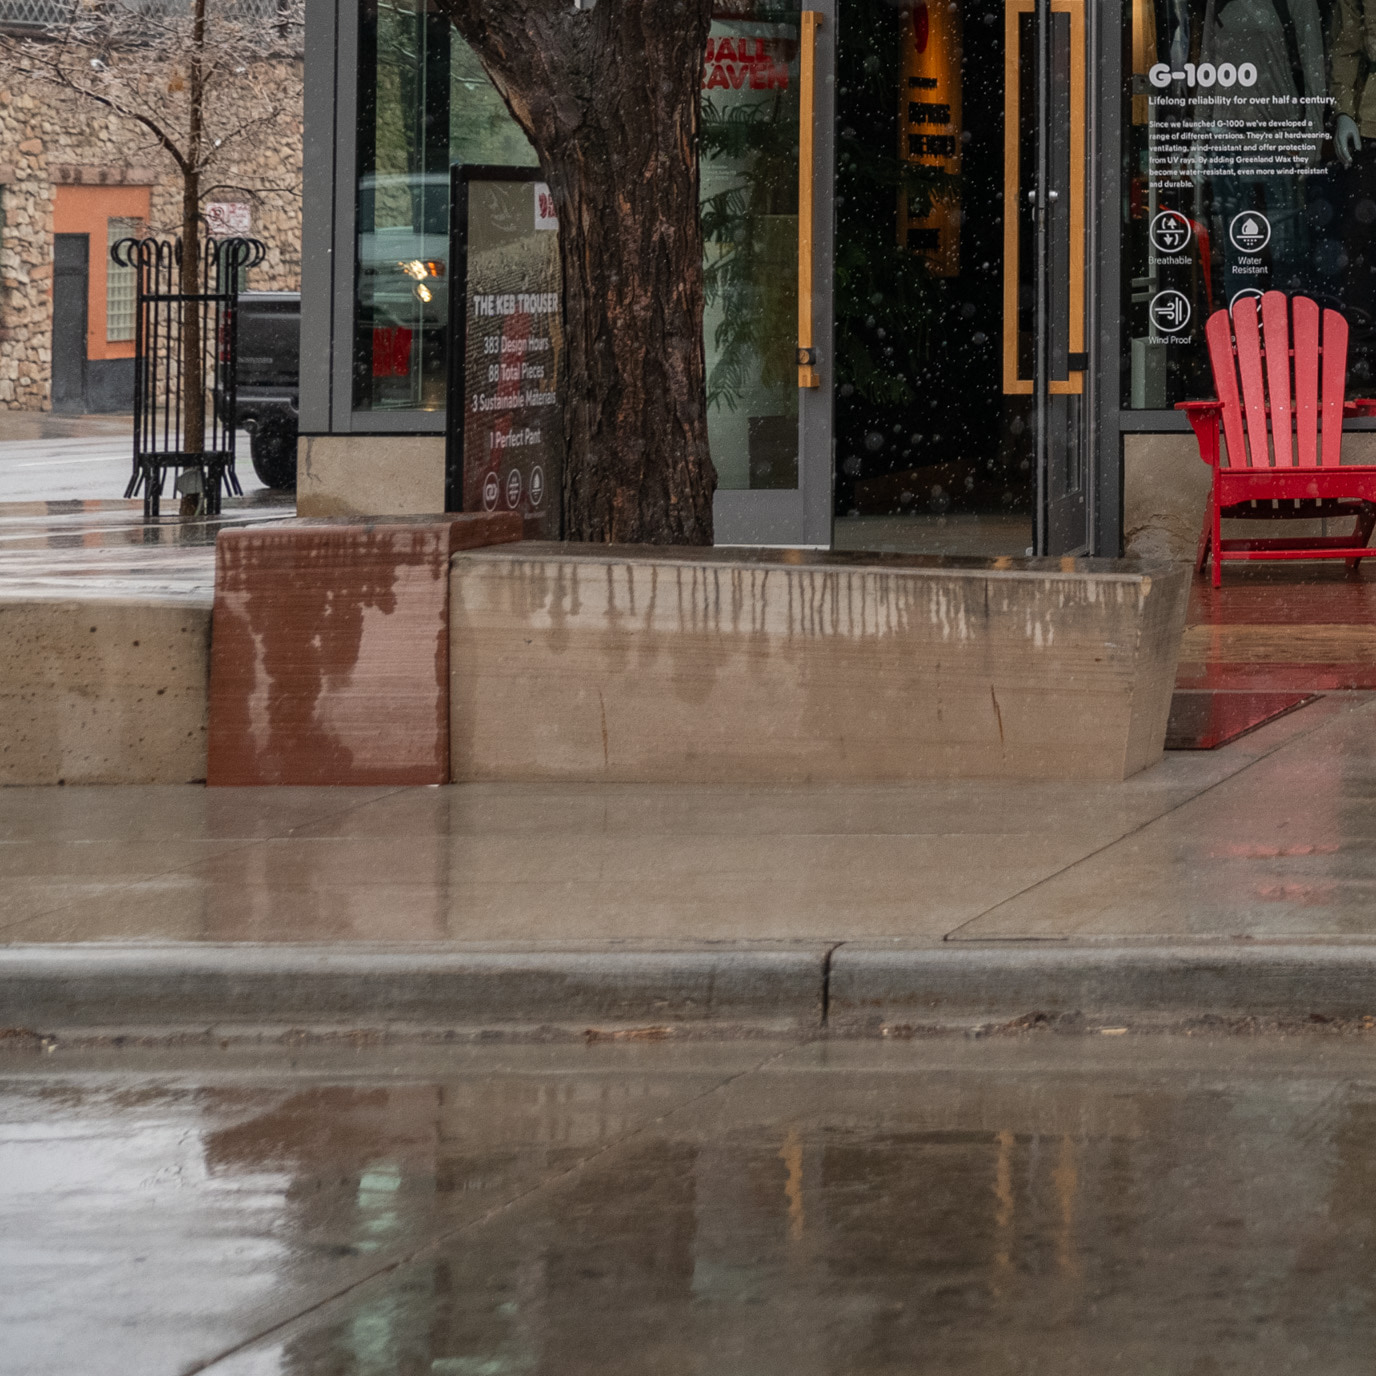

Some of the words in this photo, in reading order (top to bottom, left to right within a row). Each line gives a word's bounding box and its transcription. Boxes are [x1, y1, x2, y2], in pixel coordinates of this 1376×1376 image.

[1149, 62, 1258, 88] G-1000
[1149, 95, 1186, 107] Lifelong
[1188, 95, 1231, 106] reliability
[1233, 95, 1247, 105] for
[1249, 96, 1270, 105] over
[1272, 95, 1290, 104] half
[1300, 96, 1337, 106] century.
[1149, 120, 1169, 128] Since
[1182, 120, 1215, 128] launched
[1217, 120, 1245, 128] G-1000
[1268, 119, 1307, 128] developed
[1149, 133, 1170, 141] range
[1180, 132, 1213, 140] different
[1277, 143, 1316, 152] protection
[1149, 156, 1166, 164] from
[1167, 156, 1179, 164] UV
[1209, 156, 1234, 164] adding
[1235, 156, 1274, 164] Greenland
[1292, 155, 1309, 164] they
[1149, 168, 1178, 176] become
[1149, 180, 1163, 188] and
[1148, 256, 1192, 264] Breathable
[1232, 266, 1268, 274] Resistant
[473, 295, 494, 316] THE
[496, 294, 515, 315] KEB
[517, 293, 558, 314] TROUSER
[1148, 336, 1169, 344] Wind
[1170, 336, 1192, 344] Proof
[484, 336, 499, 354] 383
[501, 335, 527, 355] Design
[528, 335, 549, 351] Hours
[488, 364, 499, 382] 88
[501, 363, 520, 381] Total
[521, 362, 544, 379] Pieces
[472, 394, 478, 412] 3
[480, 390, 525, 411] Sustainable
[526, 390, 556, 406] Materials
[495, 429, 523, 448] Perfect
[524, 428, 541, 445] Pant
